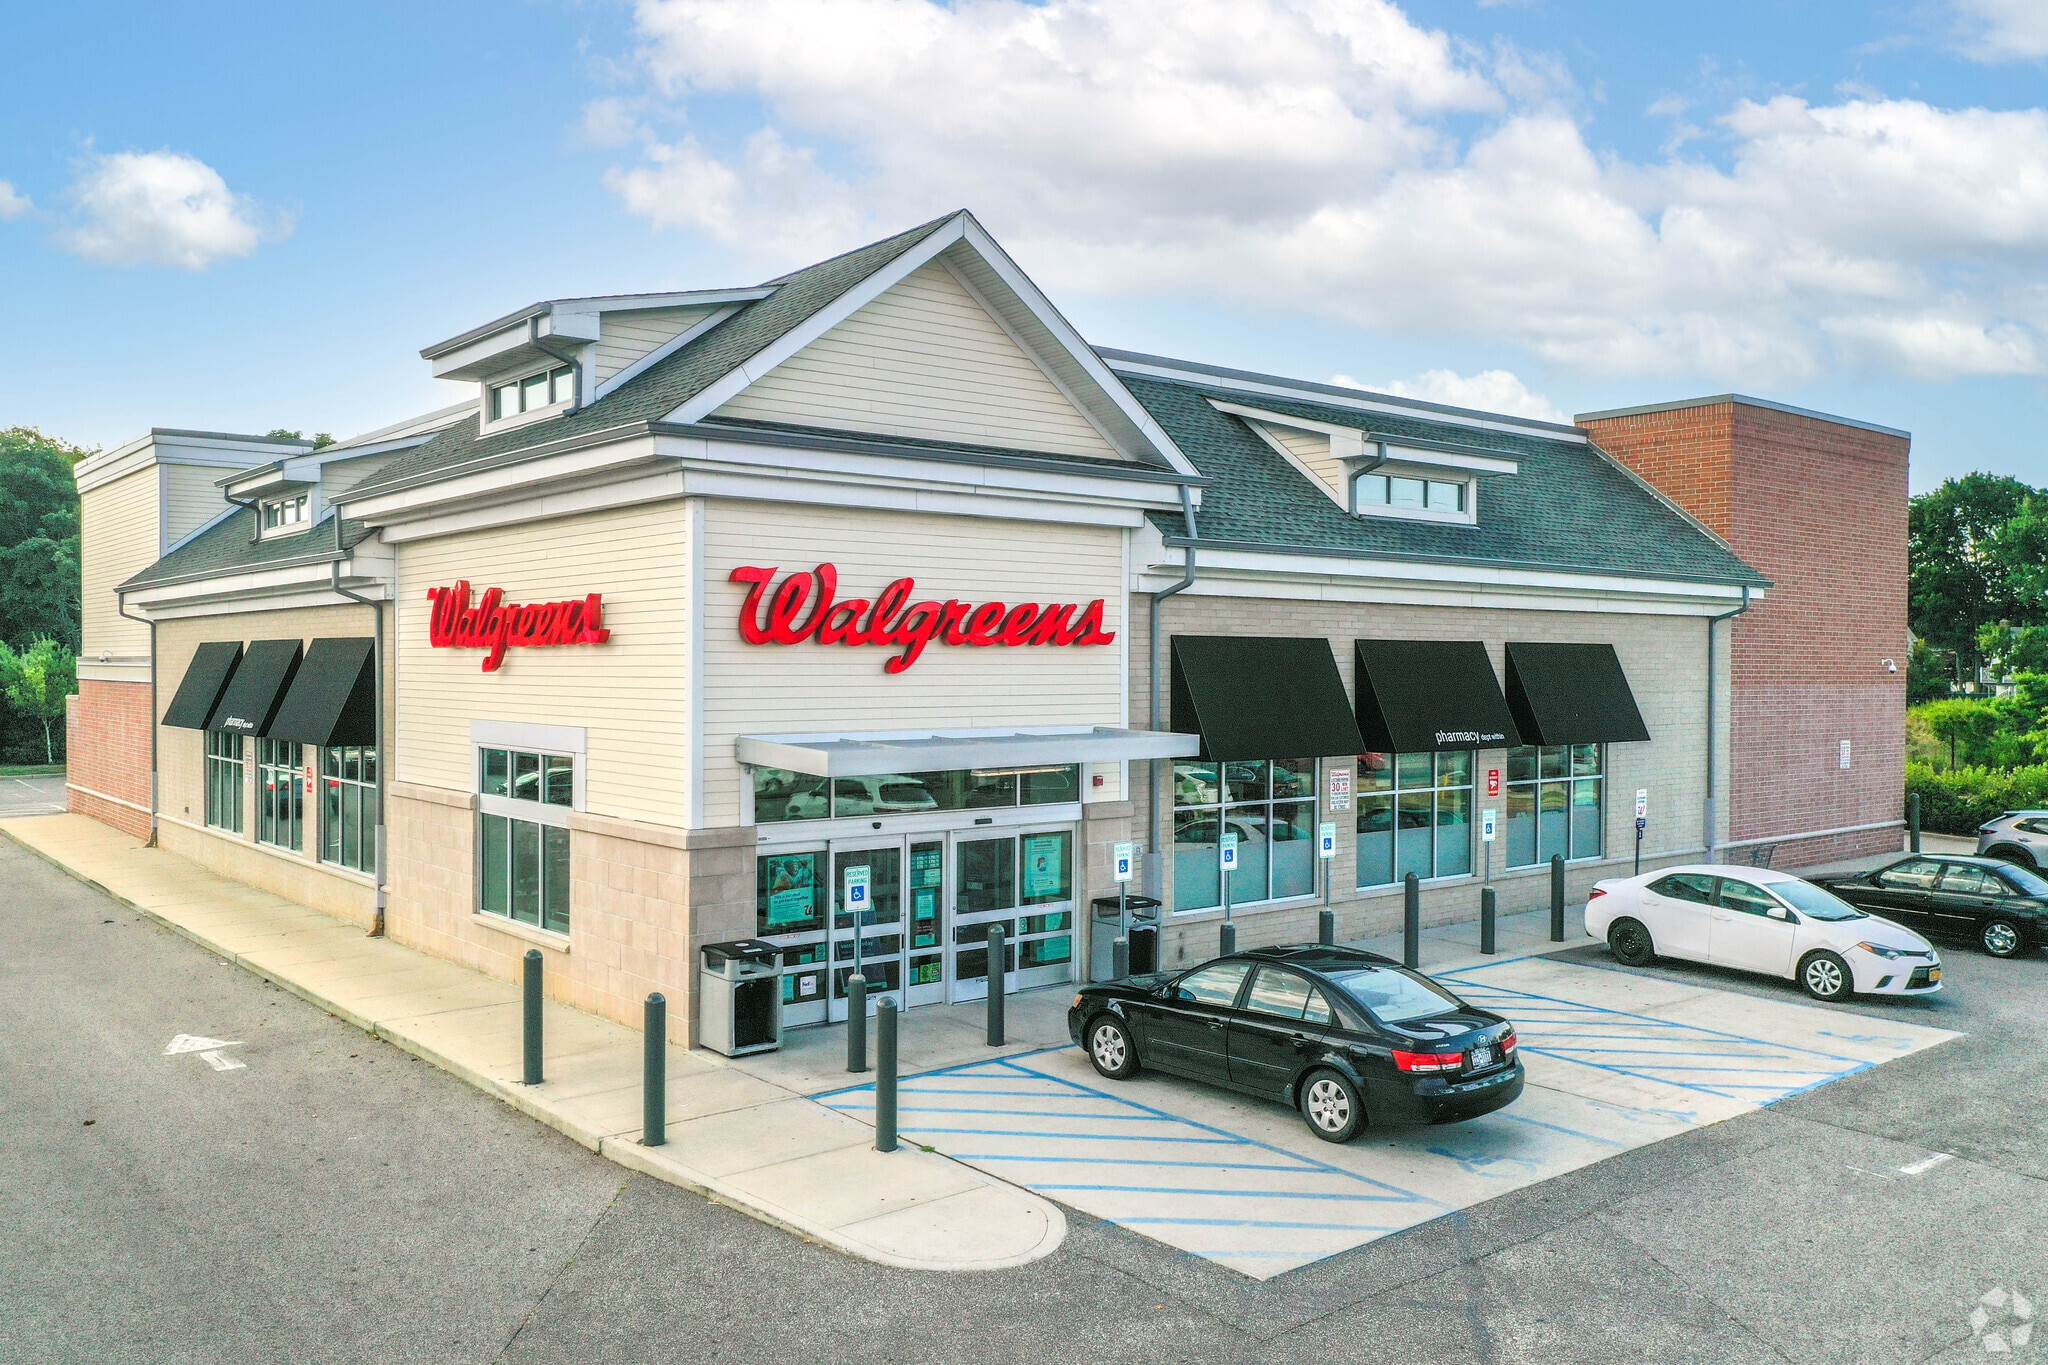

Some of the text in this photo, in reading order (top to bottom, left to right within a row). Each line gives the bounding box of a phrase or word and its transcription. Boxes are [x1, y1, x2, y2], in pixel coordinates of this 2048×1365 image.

[428, 579, 610, 673] Walgreens
[729, 563, 1115, 675] Walgreens
[1435, 729, 1480, 746] pharmacy
[1331, 782, 1341, 792] 30
[846, 870, 868, 878] RESERVED
